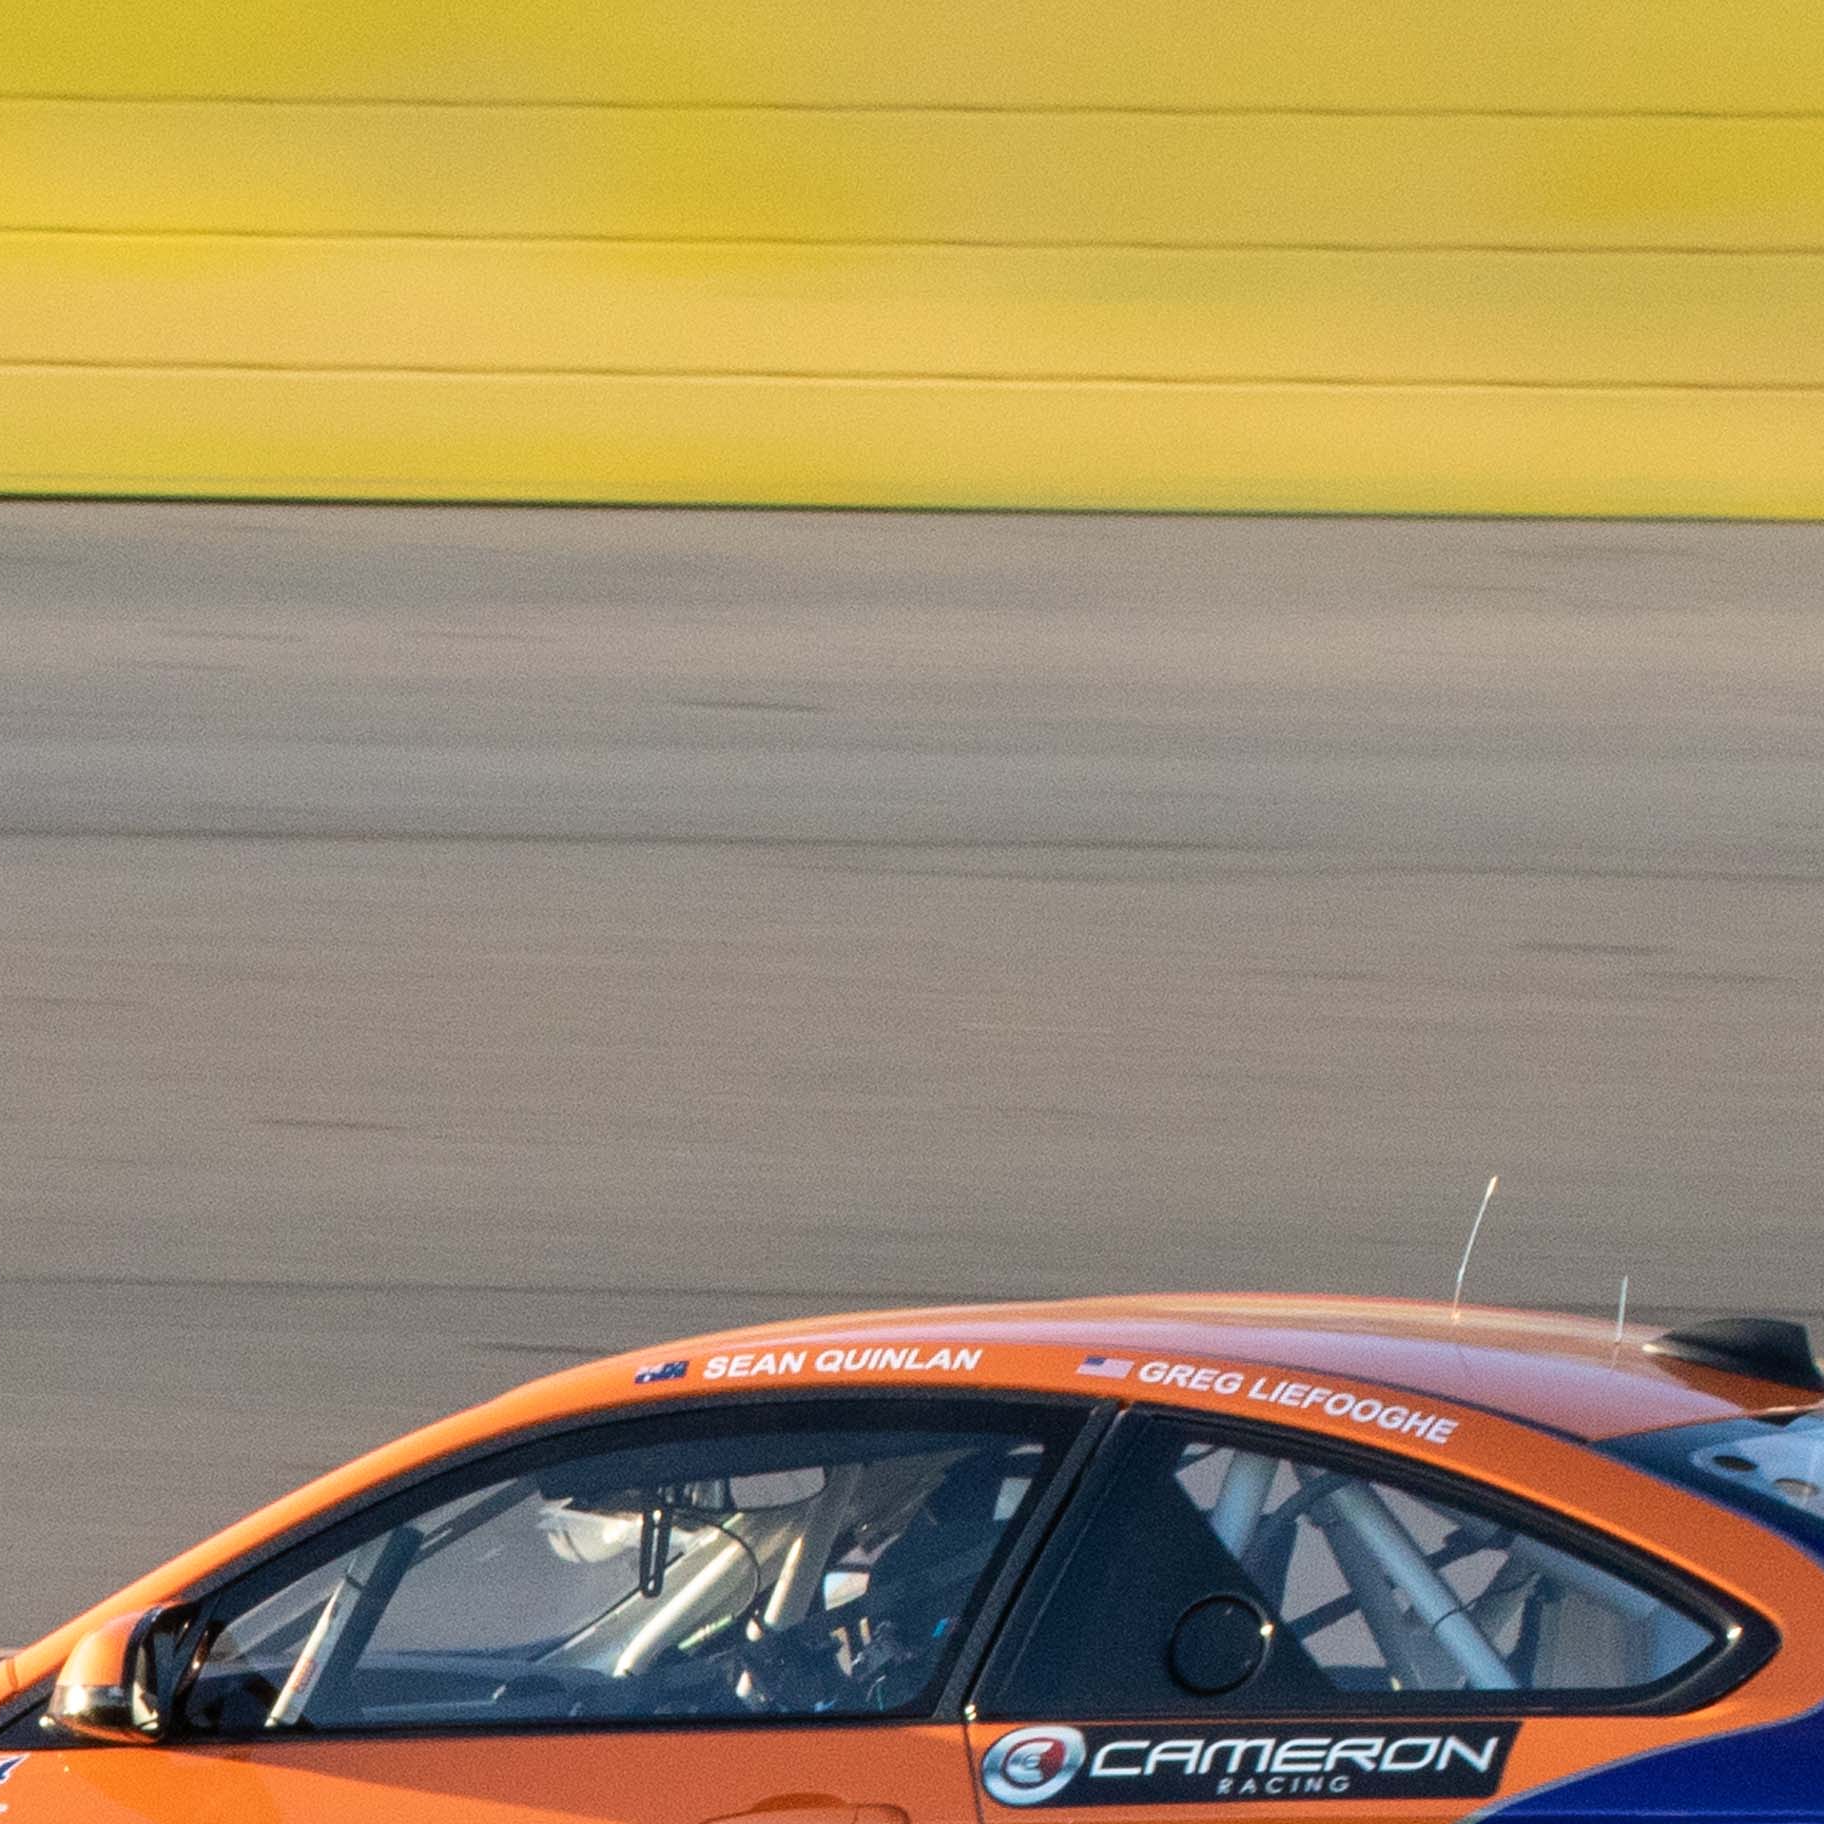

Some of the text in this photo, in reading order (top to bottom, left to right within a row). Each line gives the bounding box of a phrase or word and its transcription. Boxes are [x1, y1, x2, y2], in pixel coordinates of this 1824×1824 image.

[703, 1348, 983, 1379] SEAN QUINLAN
[1138, 1361, 1459, 1443] GREG LIEFOOGHE
[1090, 1737, 1500, 1777] CAMERON
[1216, 1776, 1351, 1795] RACING
